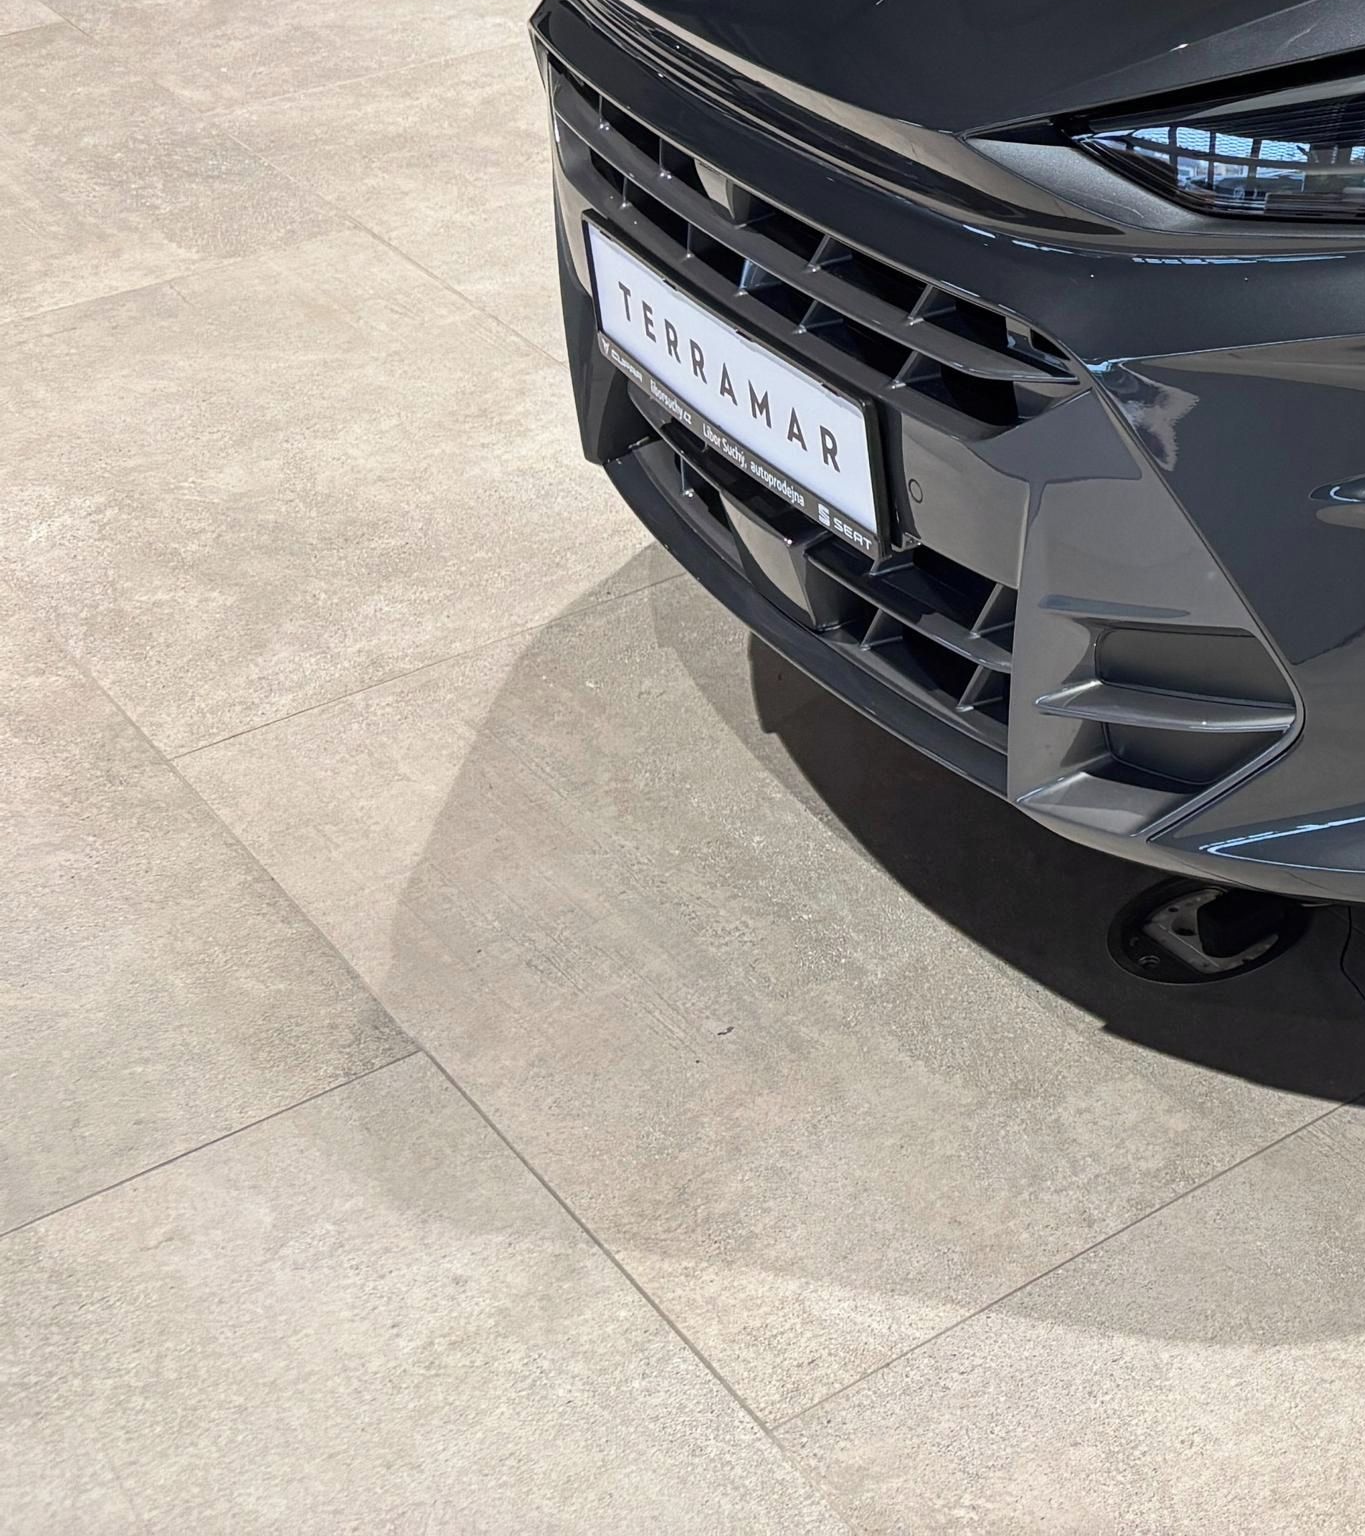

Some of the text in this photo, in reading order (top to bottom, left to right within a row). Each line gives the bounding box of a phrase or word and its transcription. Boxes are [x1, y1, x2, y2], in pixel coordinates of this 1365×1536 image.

[618, 280, 841, 473] TERRAMAR
[702, 422, 721, 446] Libor
[750, 461, 805, 507] autoprodejna
[833, 517, 872, 550] SEAT
